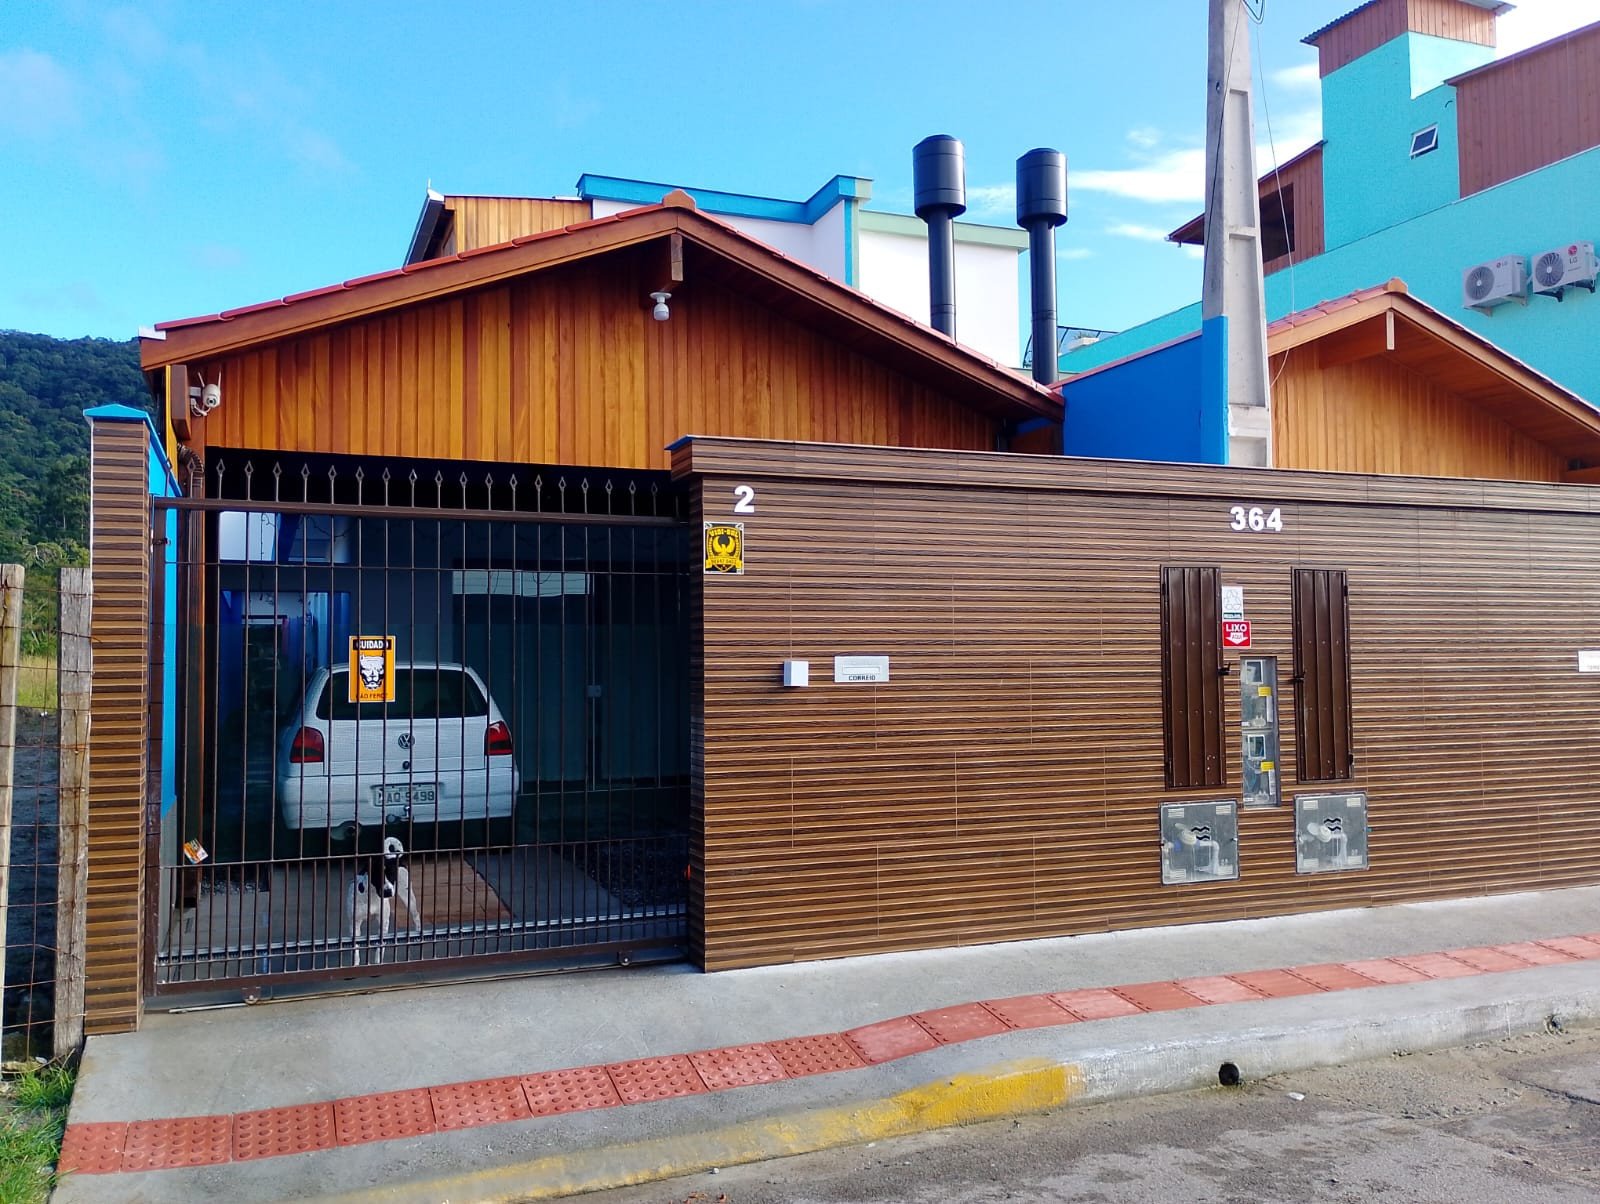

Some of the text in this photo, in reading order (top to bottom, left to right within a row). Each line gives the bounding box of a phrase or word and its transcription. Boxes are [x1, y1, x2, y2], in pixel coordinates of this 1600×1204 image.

[733, 485, 755, 513] 2
[1230, 506, 1283, 532] 364
[1225, 623, 1248, 633] LIXO
